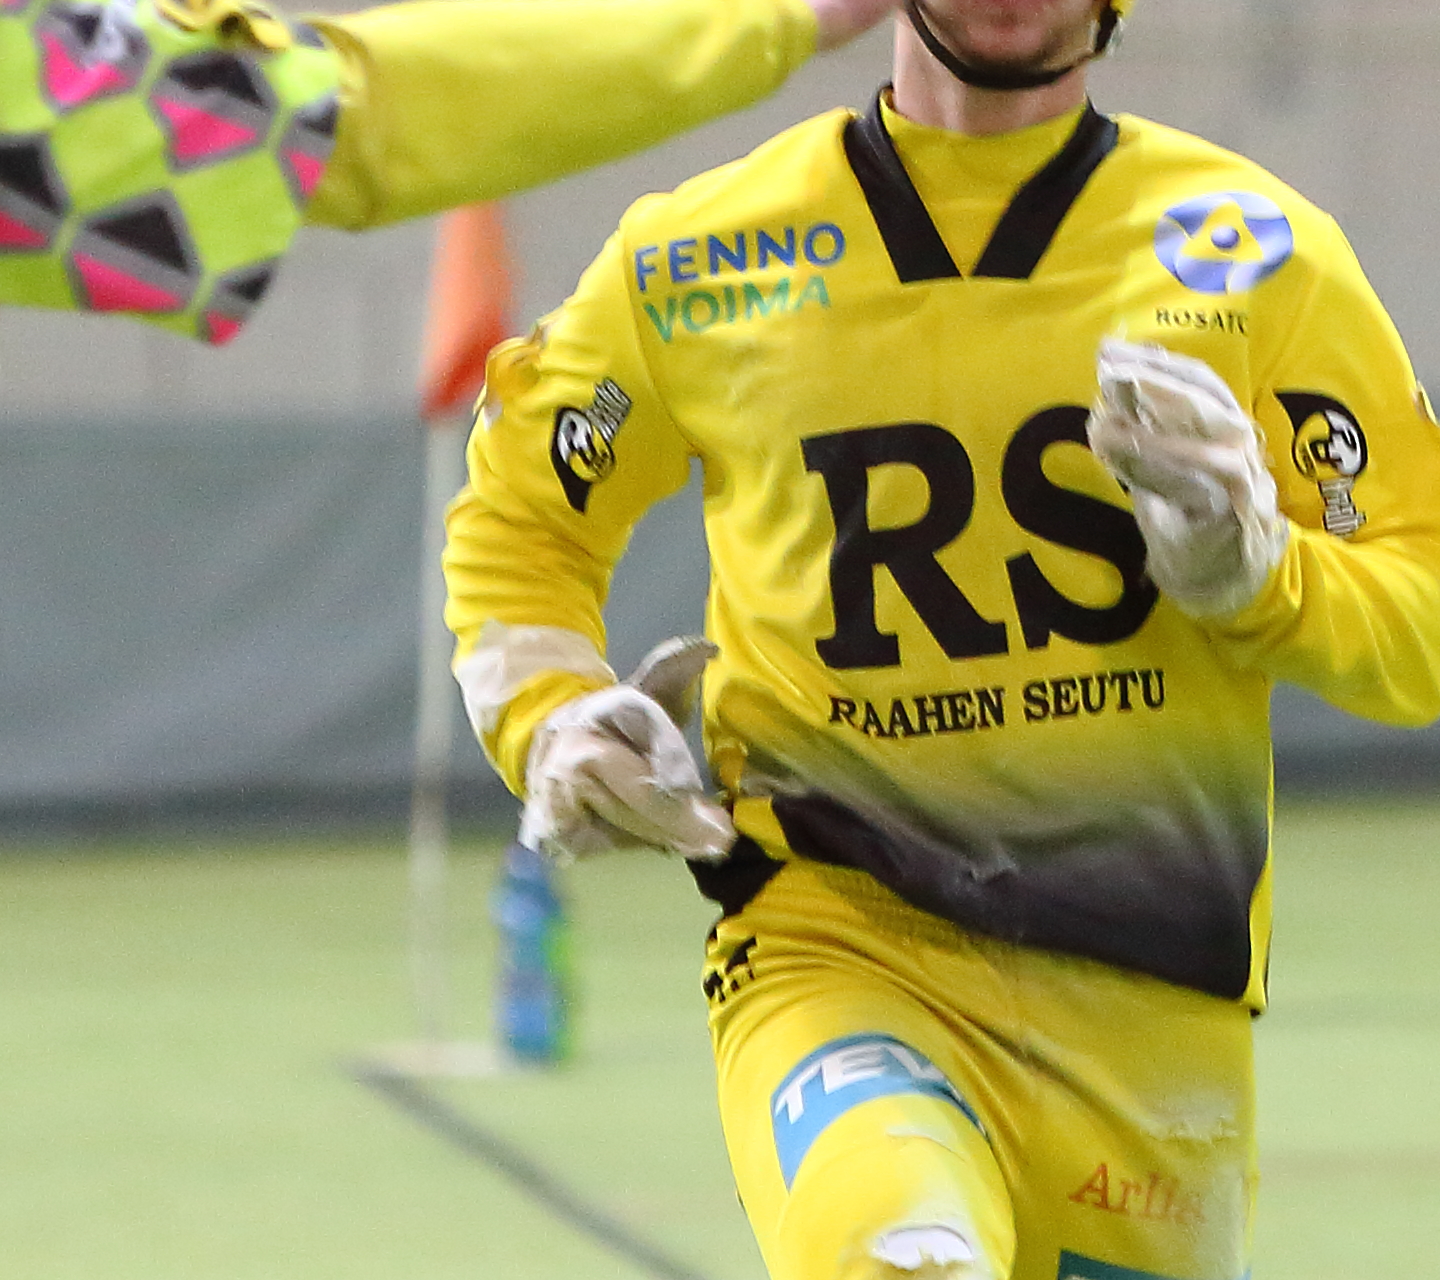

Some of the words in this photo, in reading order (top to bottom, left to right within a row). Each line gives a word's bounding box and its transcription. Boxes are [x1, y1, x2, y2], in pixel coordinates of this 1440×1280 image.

[634, 222, 847, 293] FENNO
[643, 276, 832, 344] VOIMA
[800, 404, 1160, 669] RS
[828, 693, 1006, 739] RAAHEN
[1022, 669, 1166, 724] SEUTU
[773, 1041, 946, 1125] TEV
